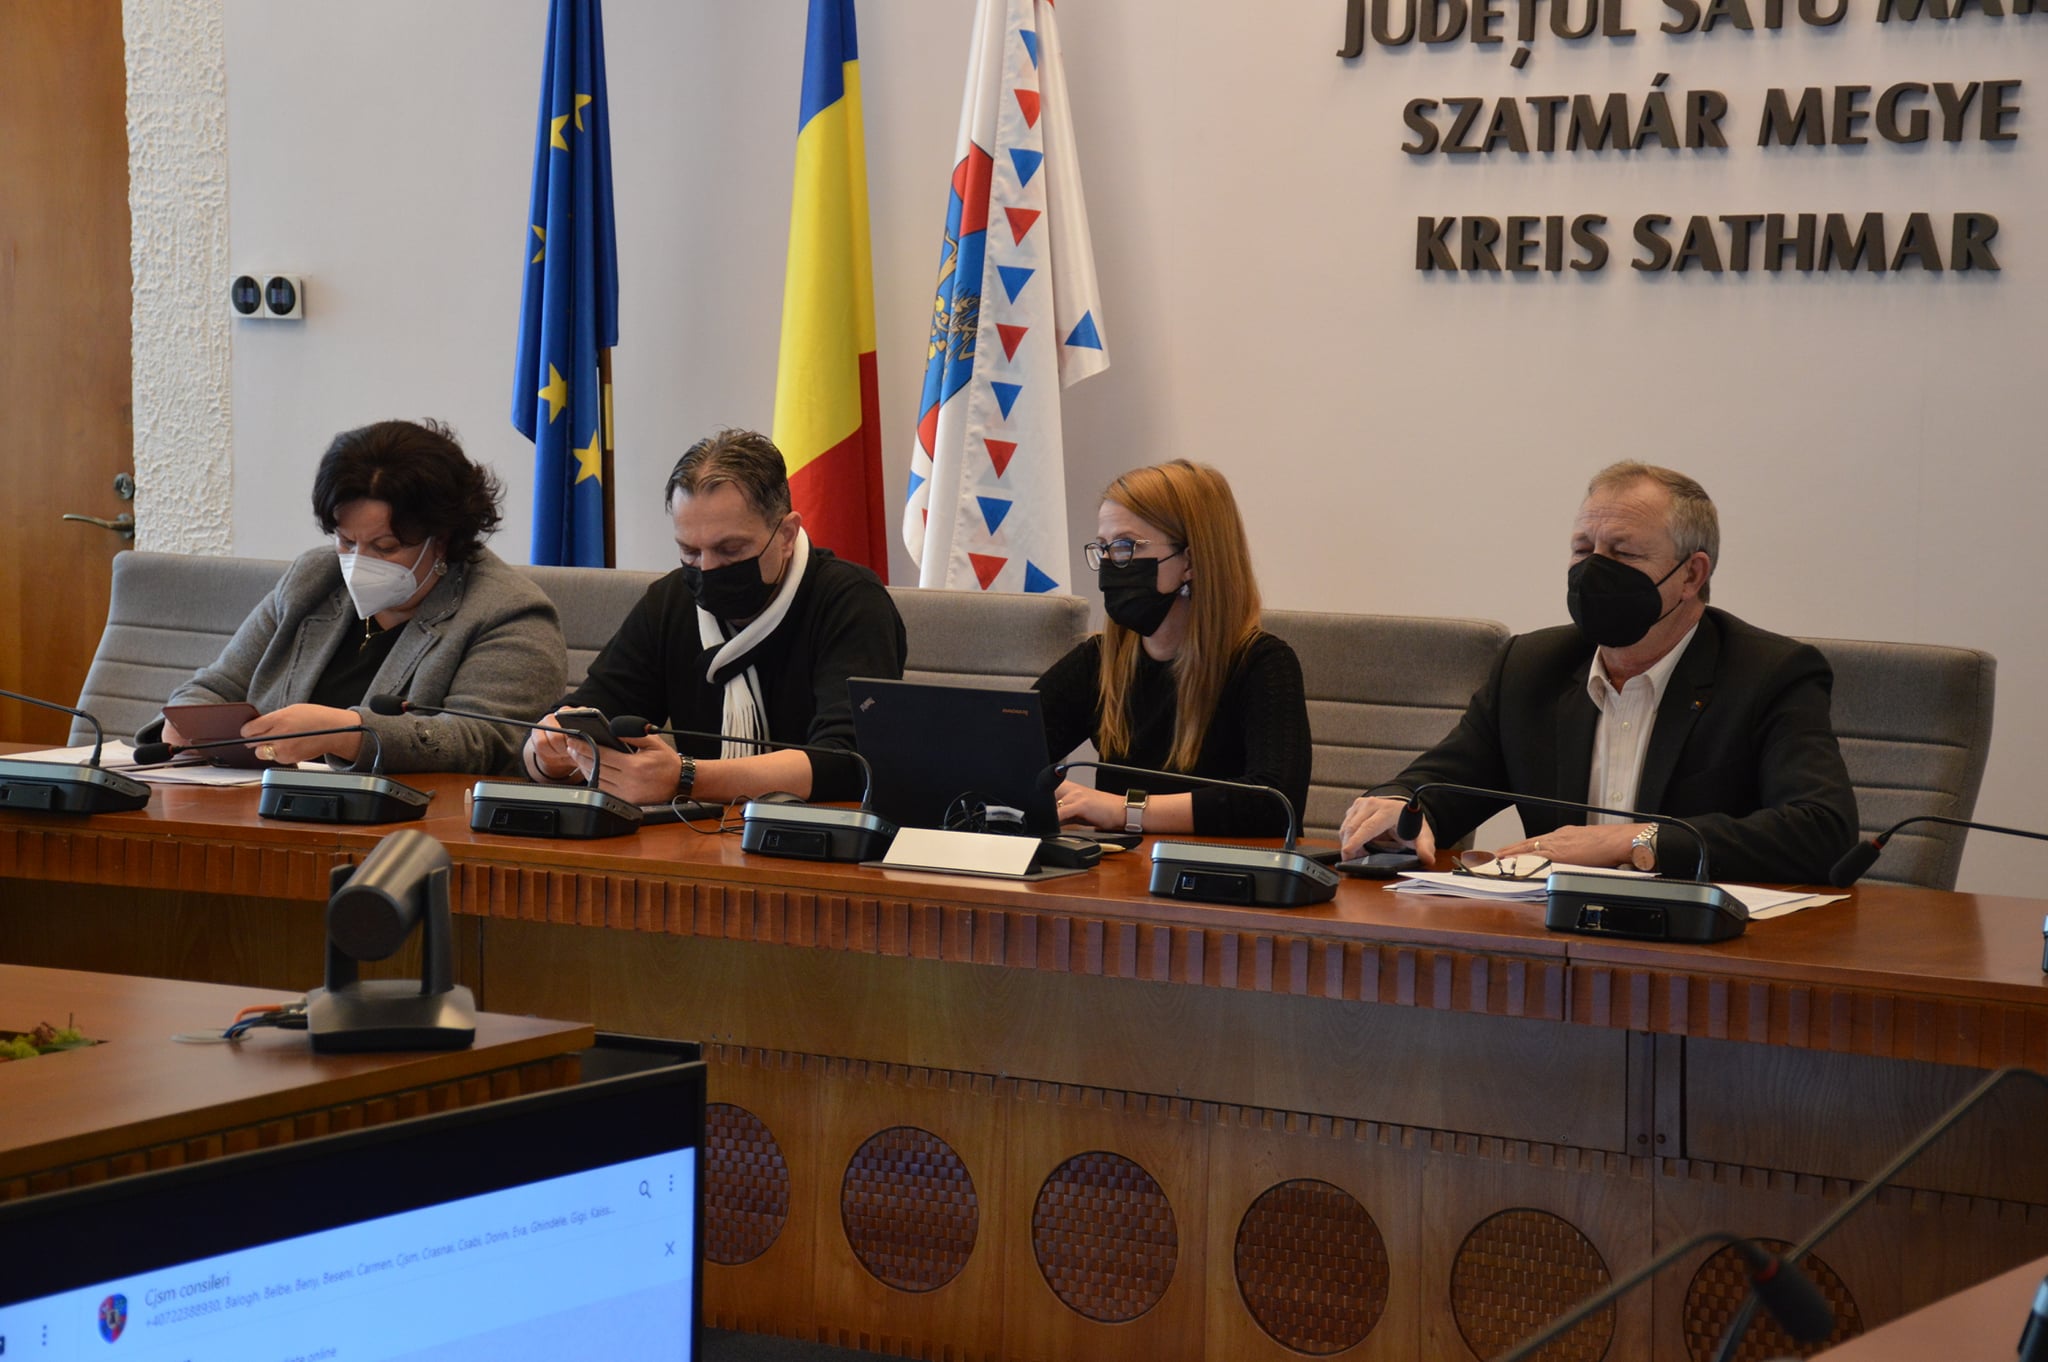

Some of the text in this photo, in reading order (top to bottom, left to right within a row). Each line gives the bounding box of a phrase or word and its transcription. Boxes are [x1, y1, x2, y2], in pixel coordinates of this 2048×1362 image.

[1402, 73, 2021, 156] SZATMÁR MEGYE
[1416, 213, 2000, 274] KREIS SATHMAR
